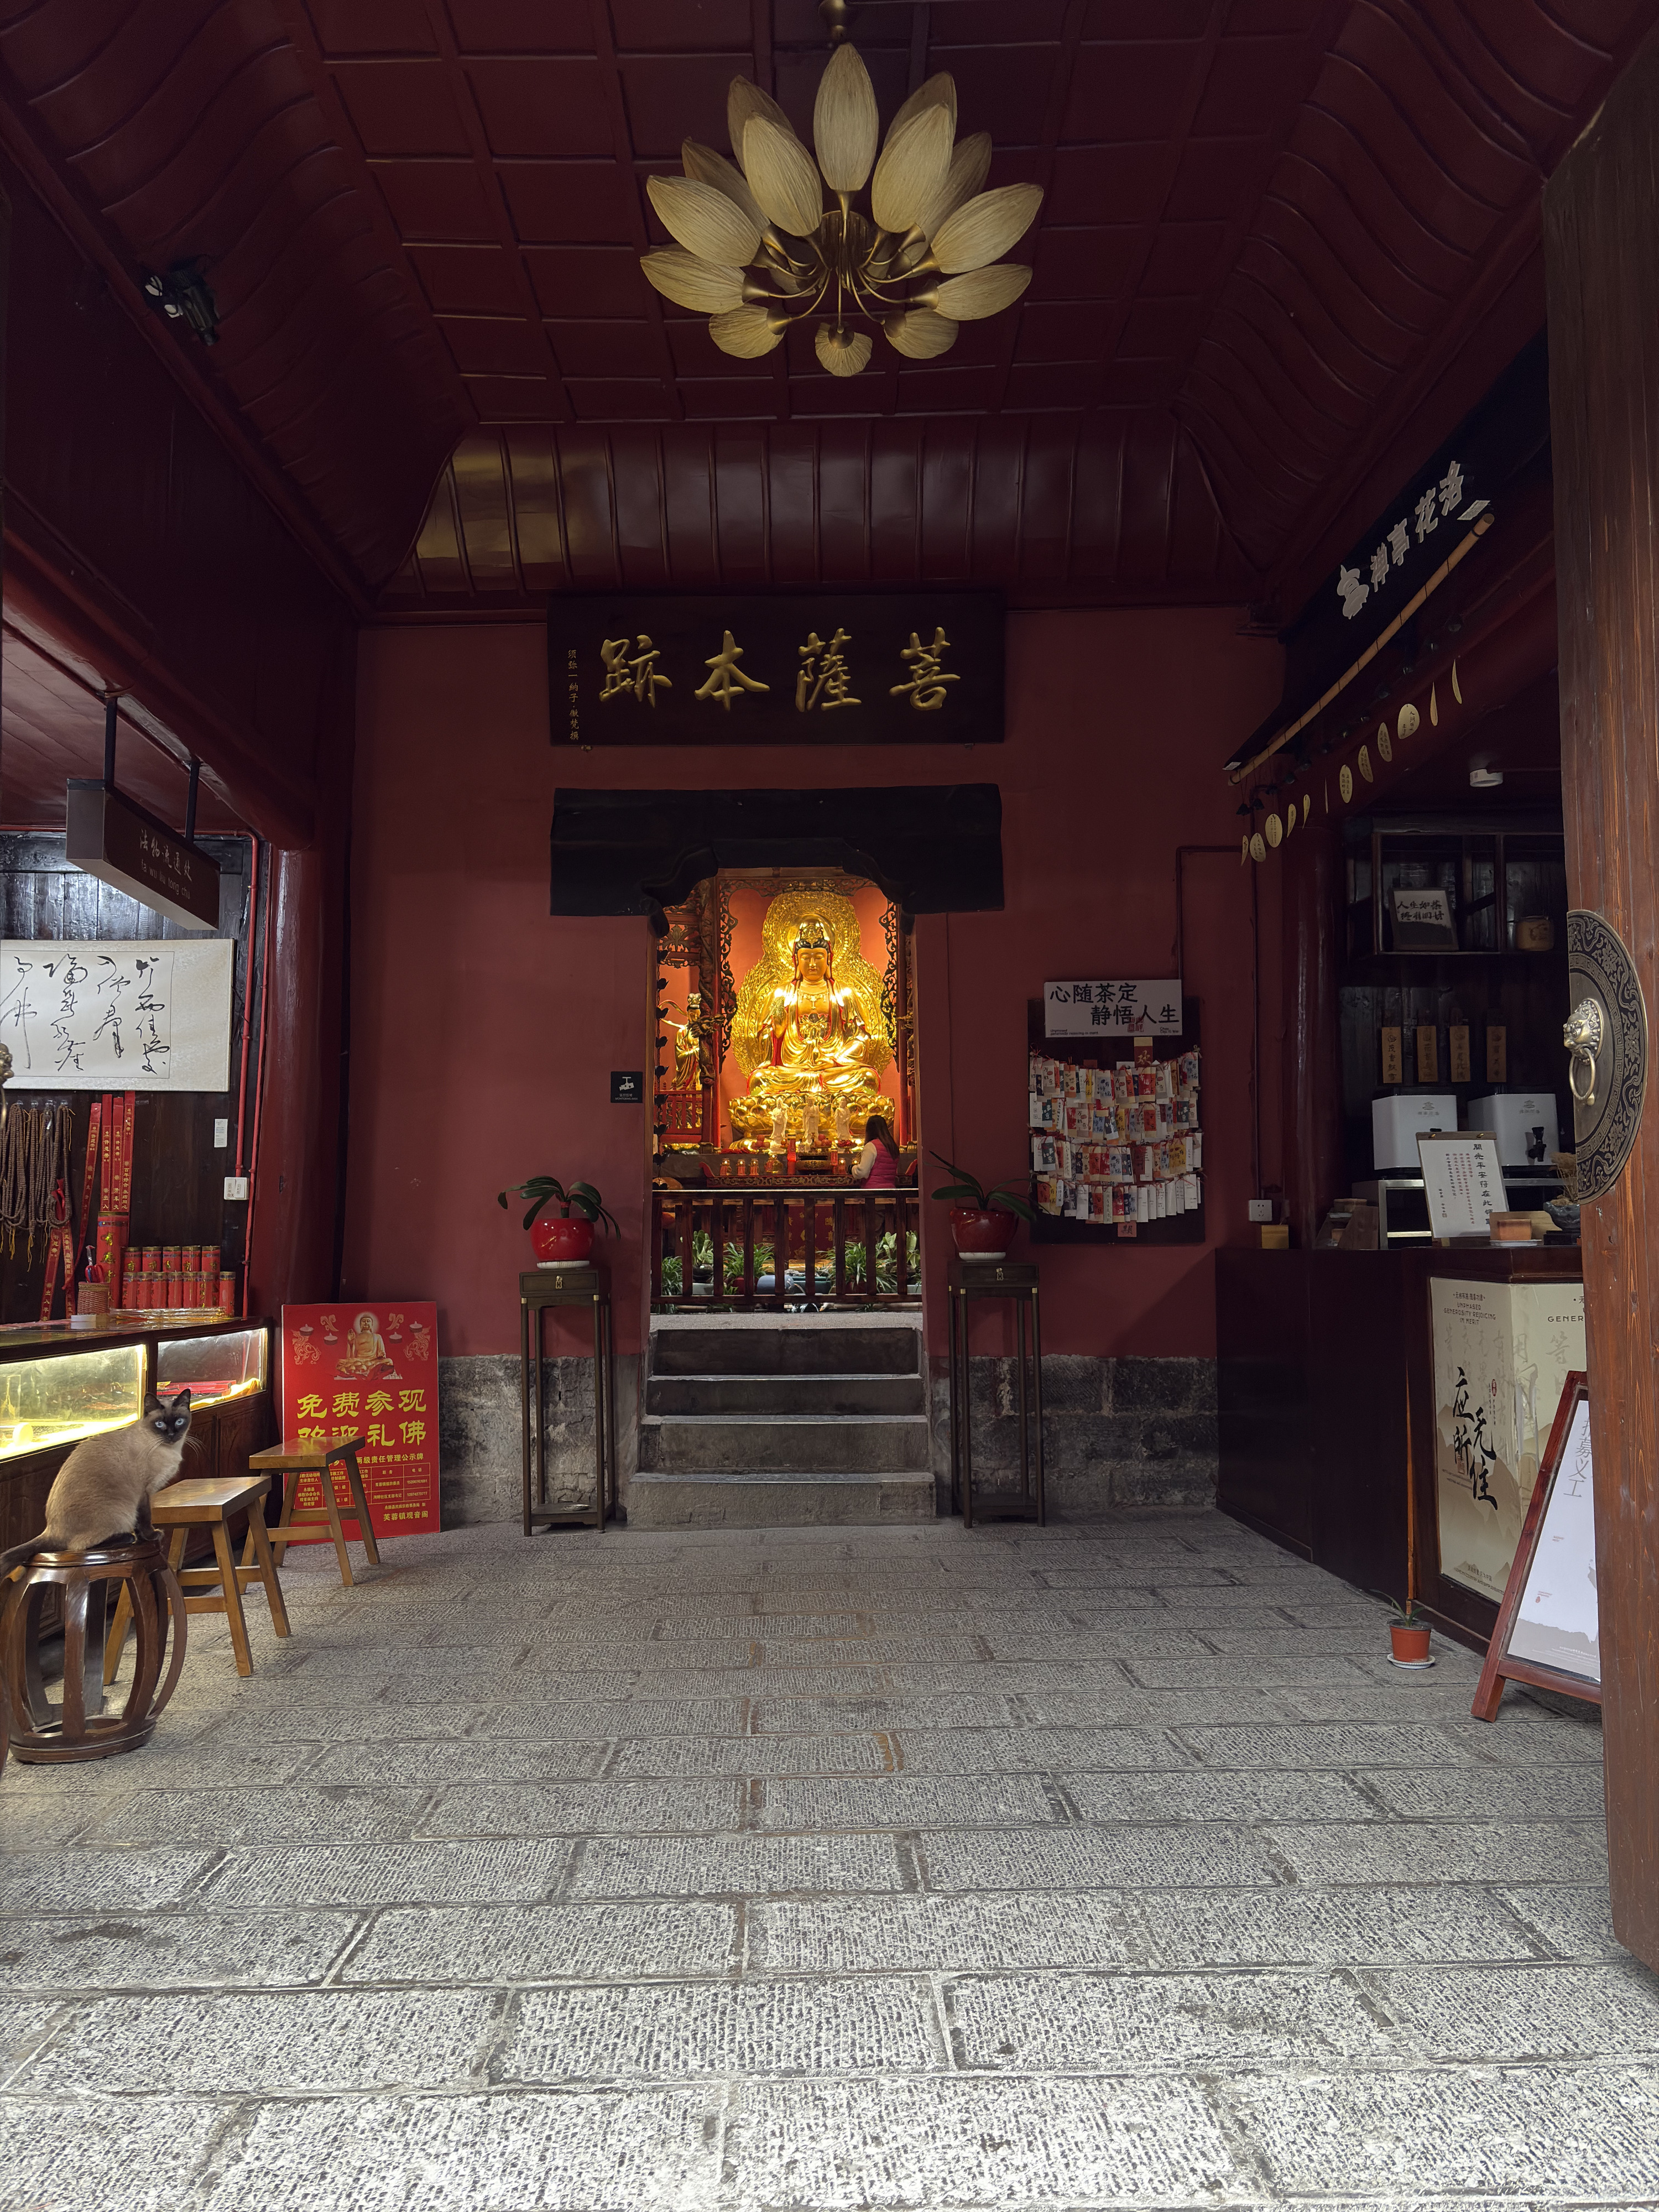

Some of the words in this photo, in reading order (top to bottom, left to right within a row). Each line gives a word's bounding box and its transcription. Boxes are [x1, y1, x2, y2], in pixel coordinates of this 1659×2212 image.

[139, 828, 192, 882] 法物流通处
[141, 858, 147, 873] fa
[149, 867, 157, 879] wu
[168, 877, 179, 895] tong
[181, 886, 191, 899] chu
[1050, 982, 1138, 1004] 心随茶定
[1090, 1004, 1180, 1026] 静悟人生
[1443, 1308, 1472, 1317] GENEROSITY
[1472, 1312, 1496, 1320] REJOICING
[1457, 1302, 1481, 1311] UNPHASED
[297, 1389, 427, 1420] 免费参观
[383, 1510, 429, 1522] 芙蓉镇观音阁
